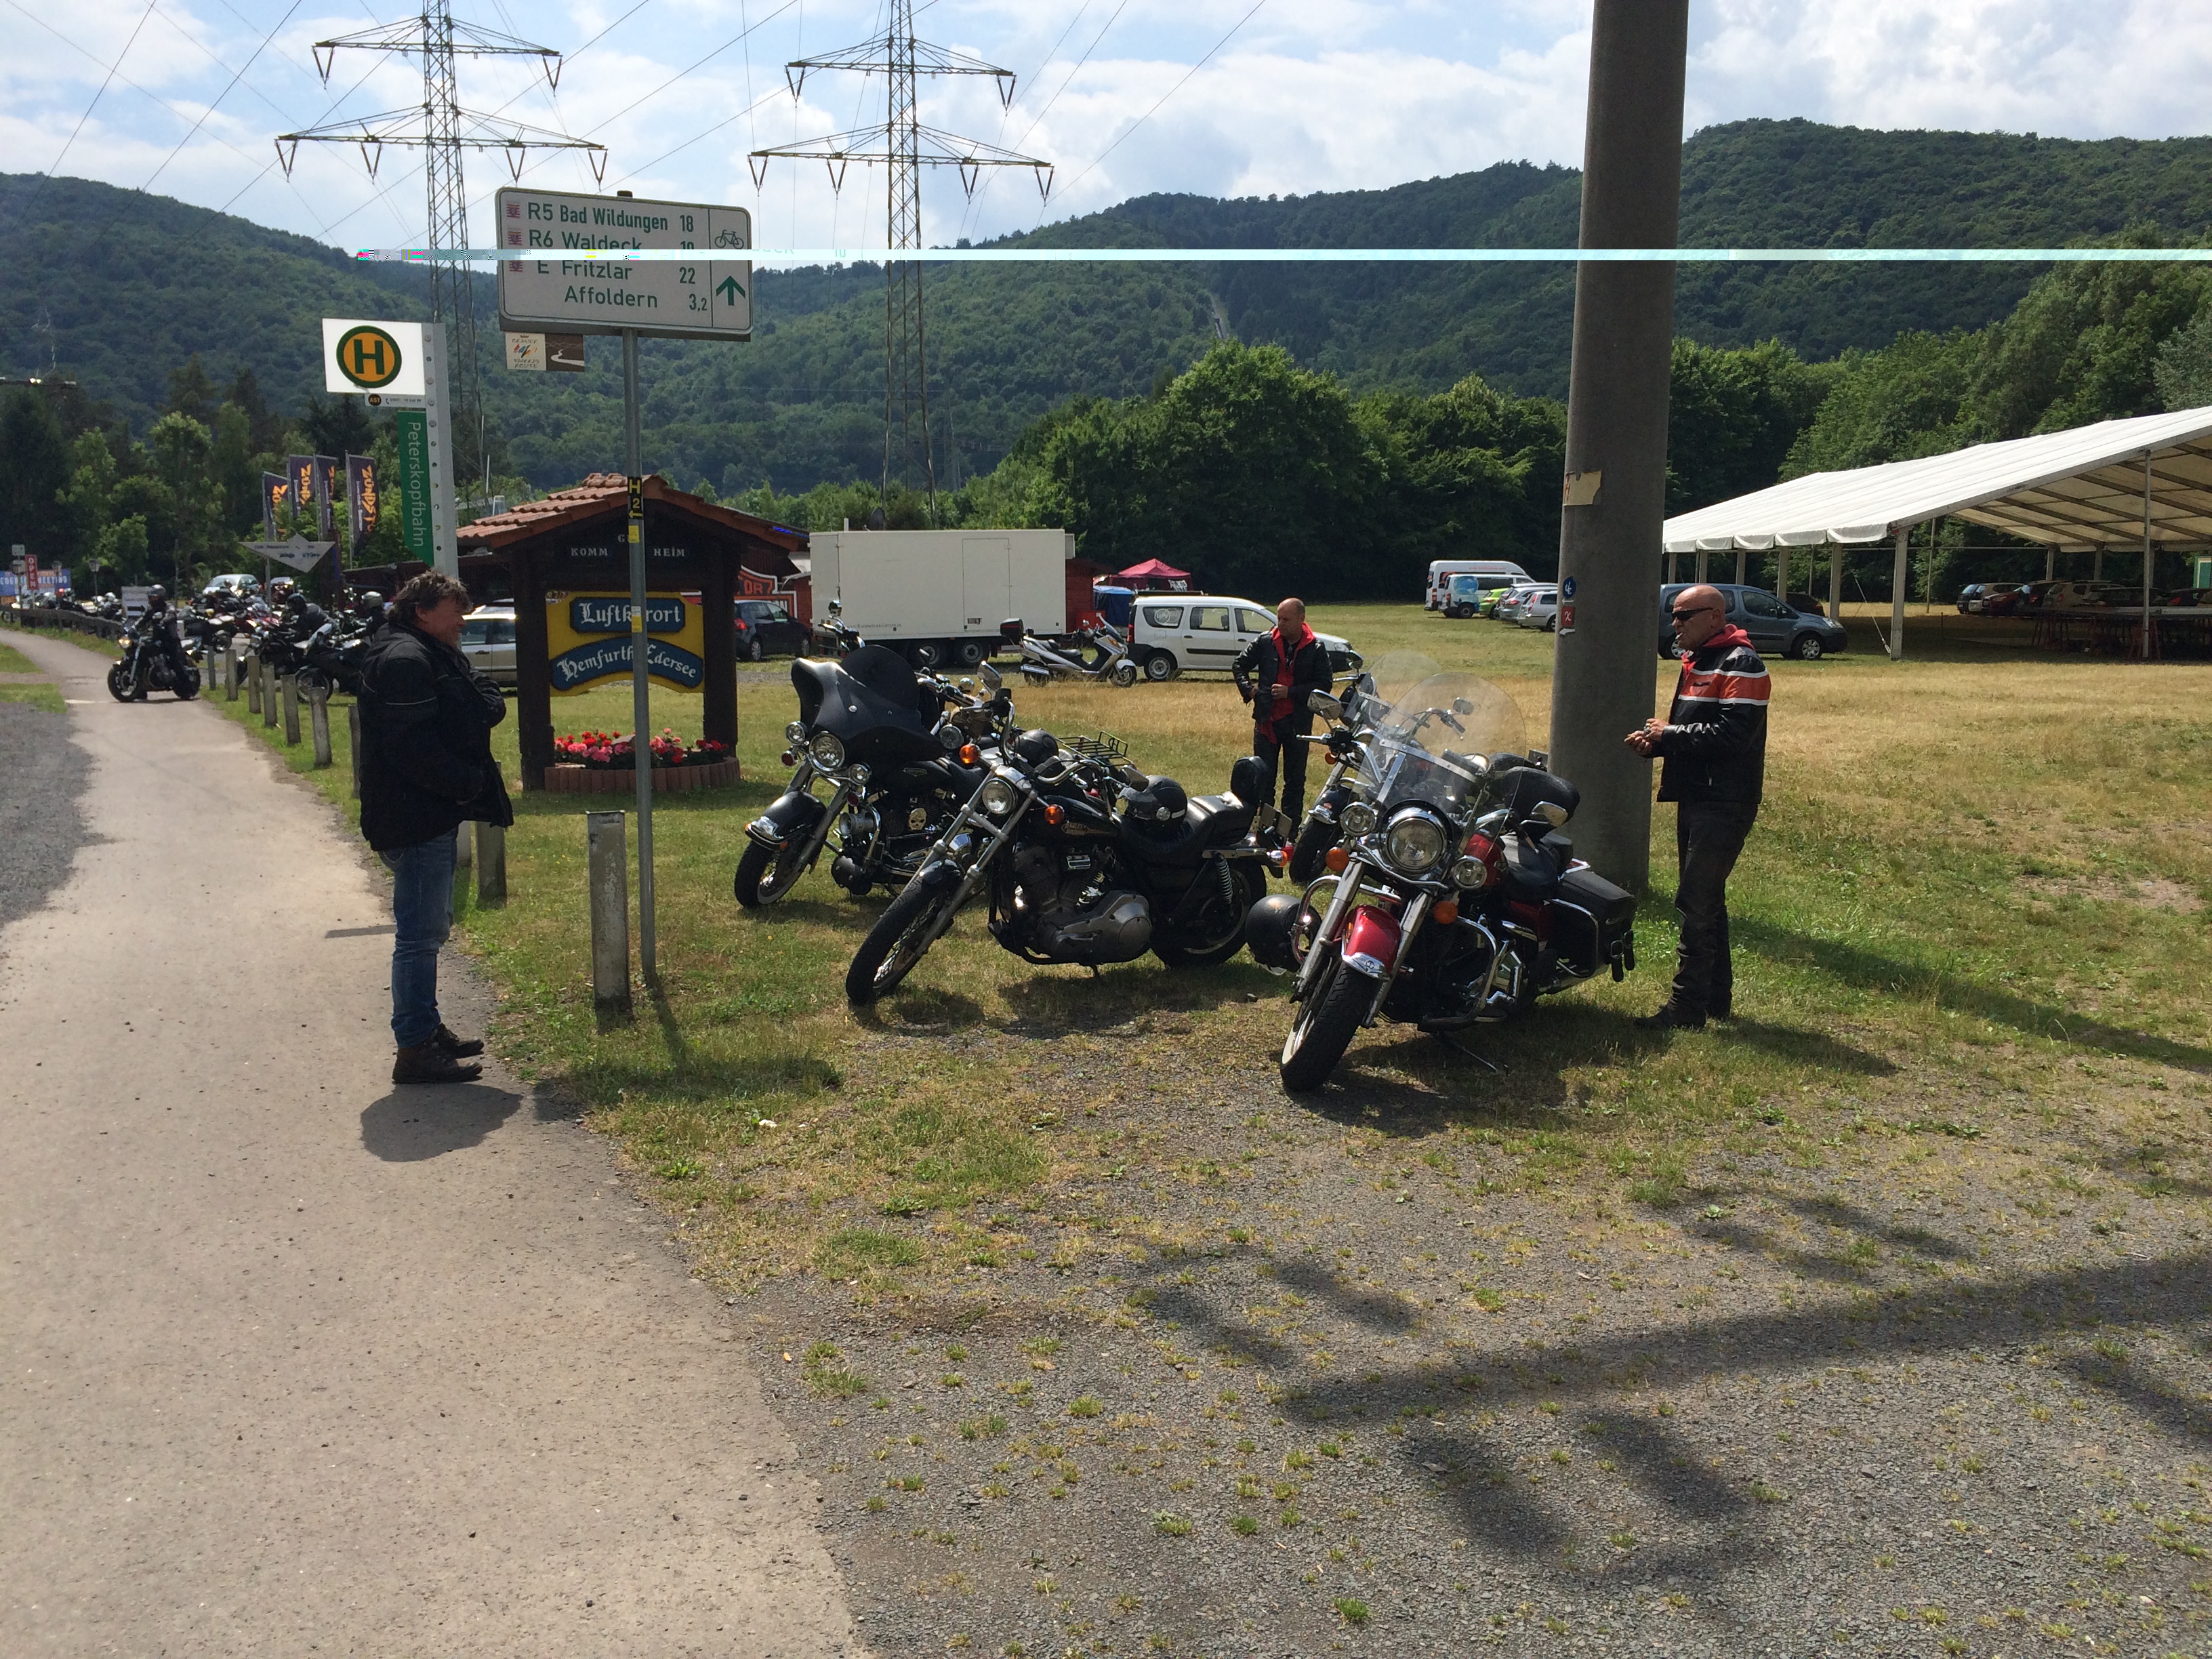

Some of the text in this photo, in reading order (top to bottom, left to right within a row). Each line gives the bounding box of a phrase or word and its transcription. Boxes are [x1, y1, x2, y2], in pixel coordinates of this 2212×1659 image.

[528, 202, 694, 233] R5 Bad Wildungen 18
[529, 229, 553, 248] R6
[562, 231, 642, 250] Waldeck
[562, 260, 633, 280] Fritzlar
[679, 266, 696, 285] 22
[565, 285, 708, 312] Affoldern 3,2
[354, 339, 385, 375] H
[407, 422, 427, 548] Peterskopfbahn
[628, 479, 640, 494] H
[632, 498, 640, 509] 2
[571, 548, 609, 556] KOMM
[28, 558, 37, 588] OPEN
[579, 602, 680, 627] Luftkrort
